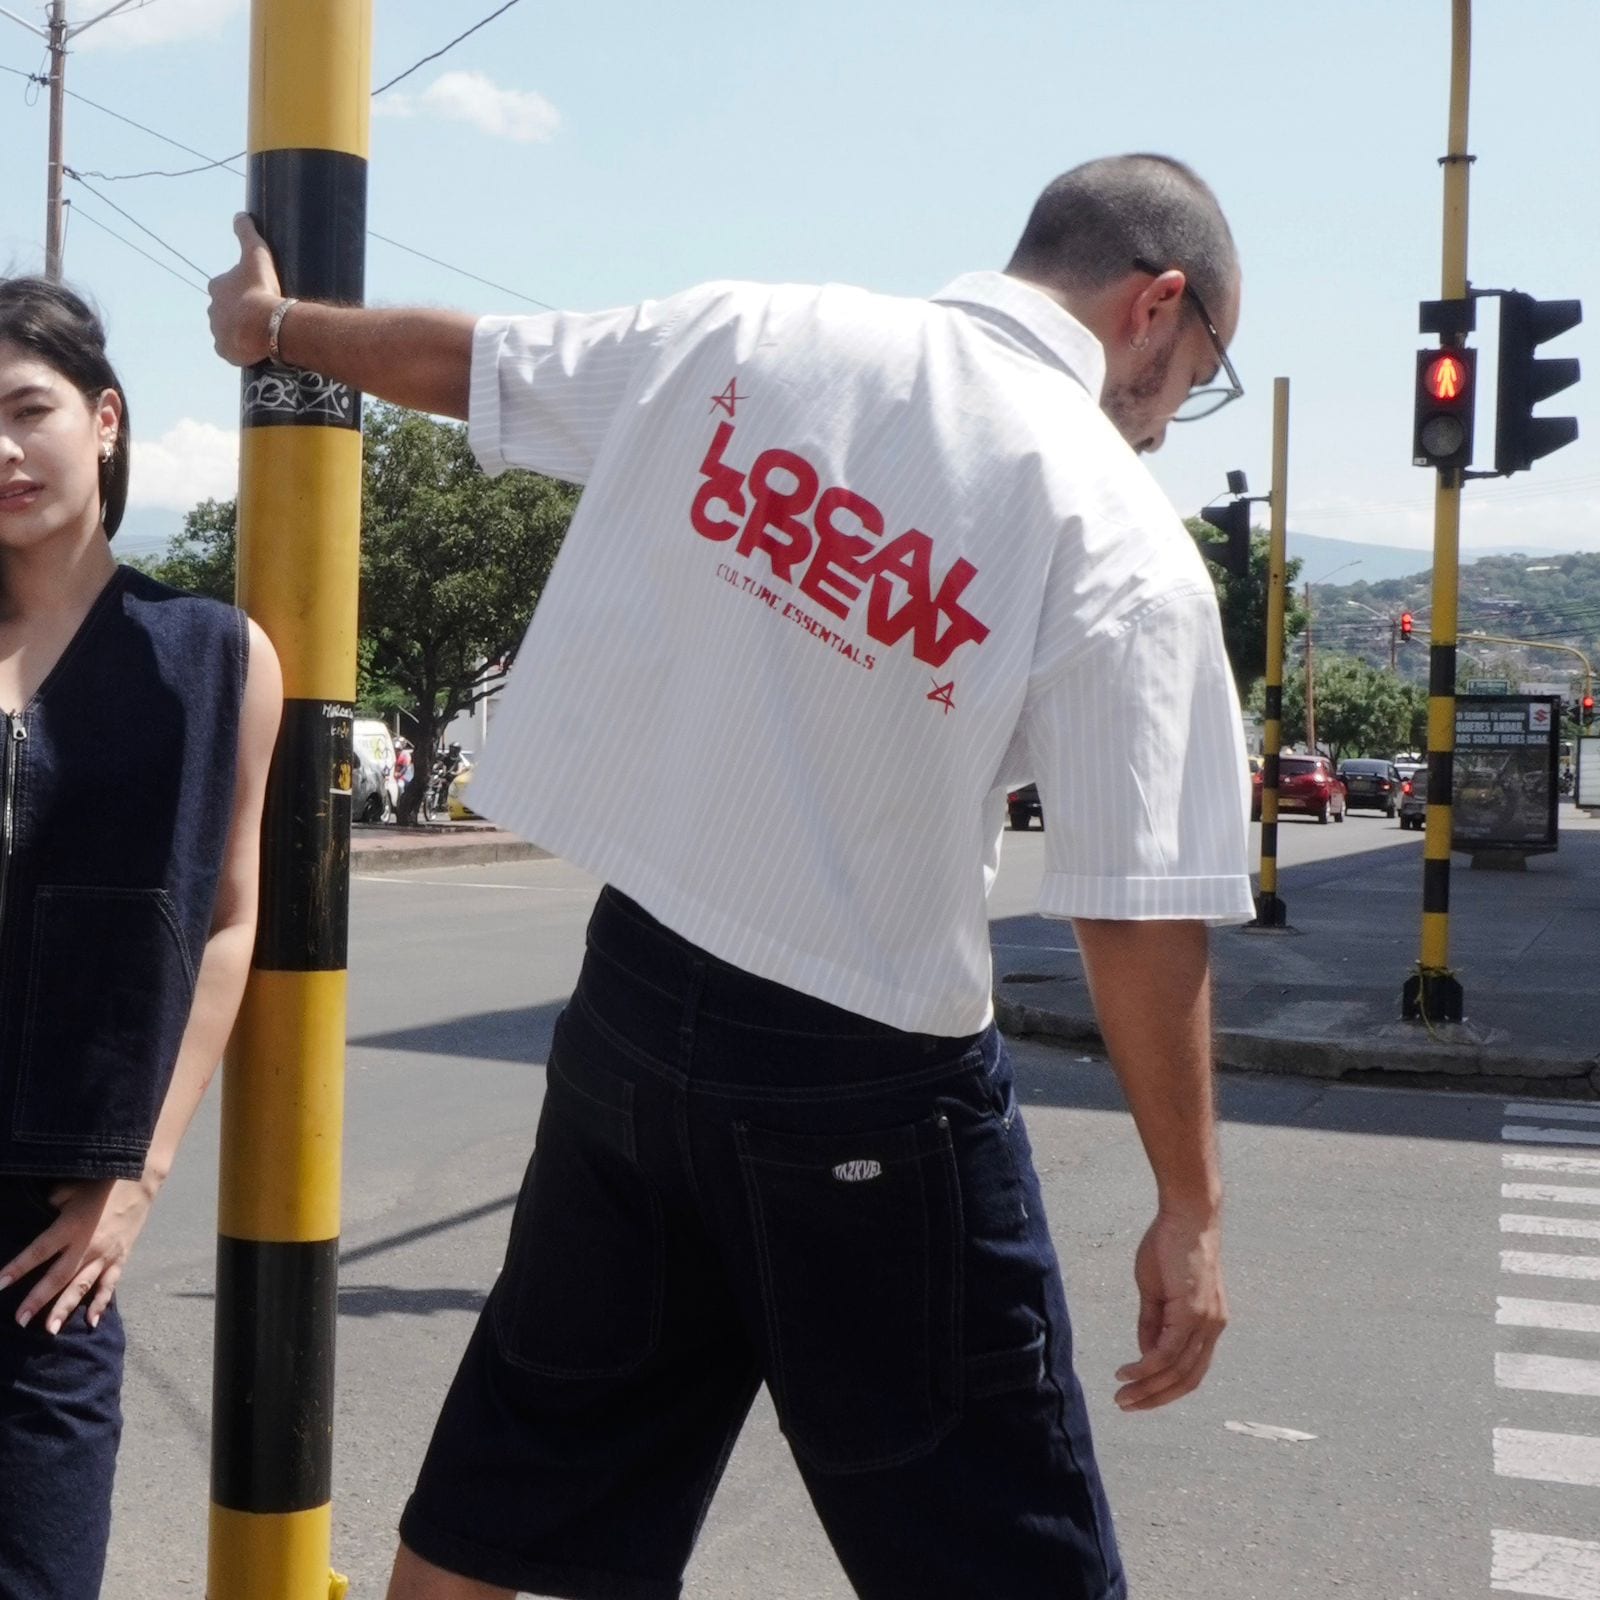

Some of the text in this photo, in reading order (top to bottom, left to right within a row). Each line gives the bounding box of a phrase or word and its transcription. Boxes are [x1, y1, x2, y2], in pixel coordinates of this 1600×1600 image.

[691, 477, 979, 668] CREW
[699, 420, 991, 645] LOCAL
[716, 563, 876, 670] CULTURE ESSENTIALS
[1456, 721, 1491, 732] QUIERES
